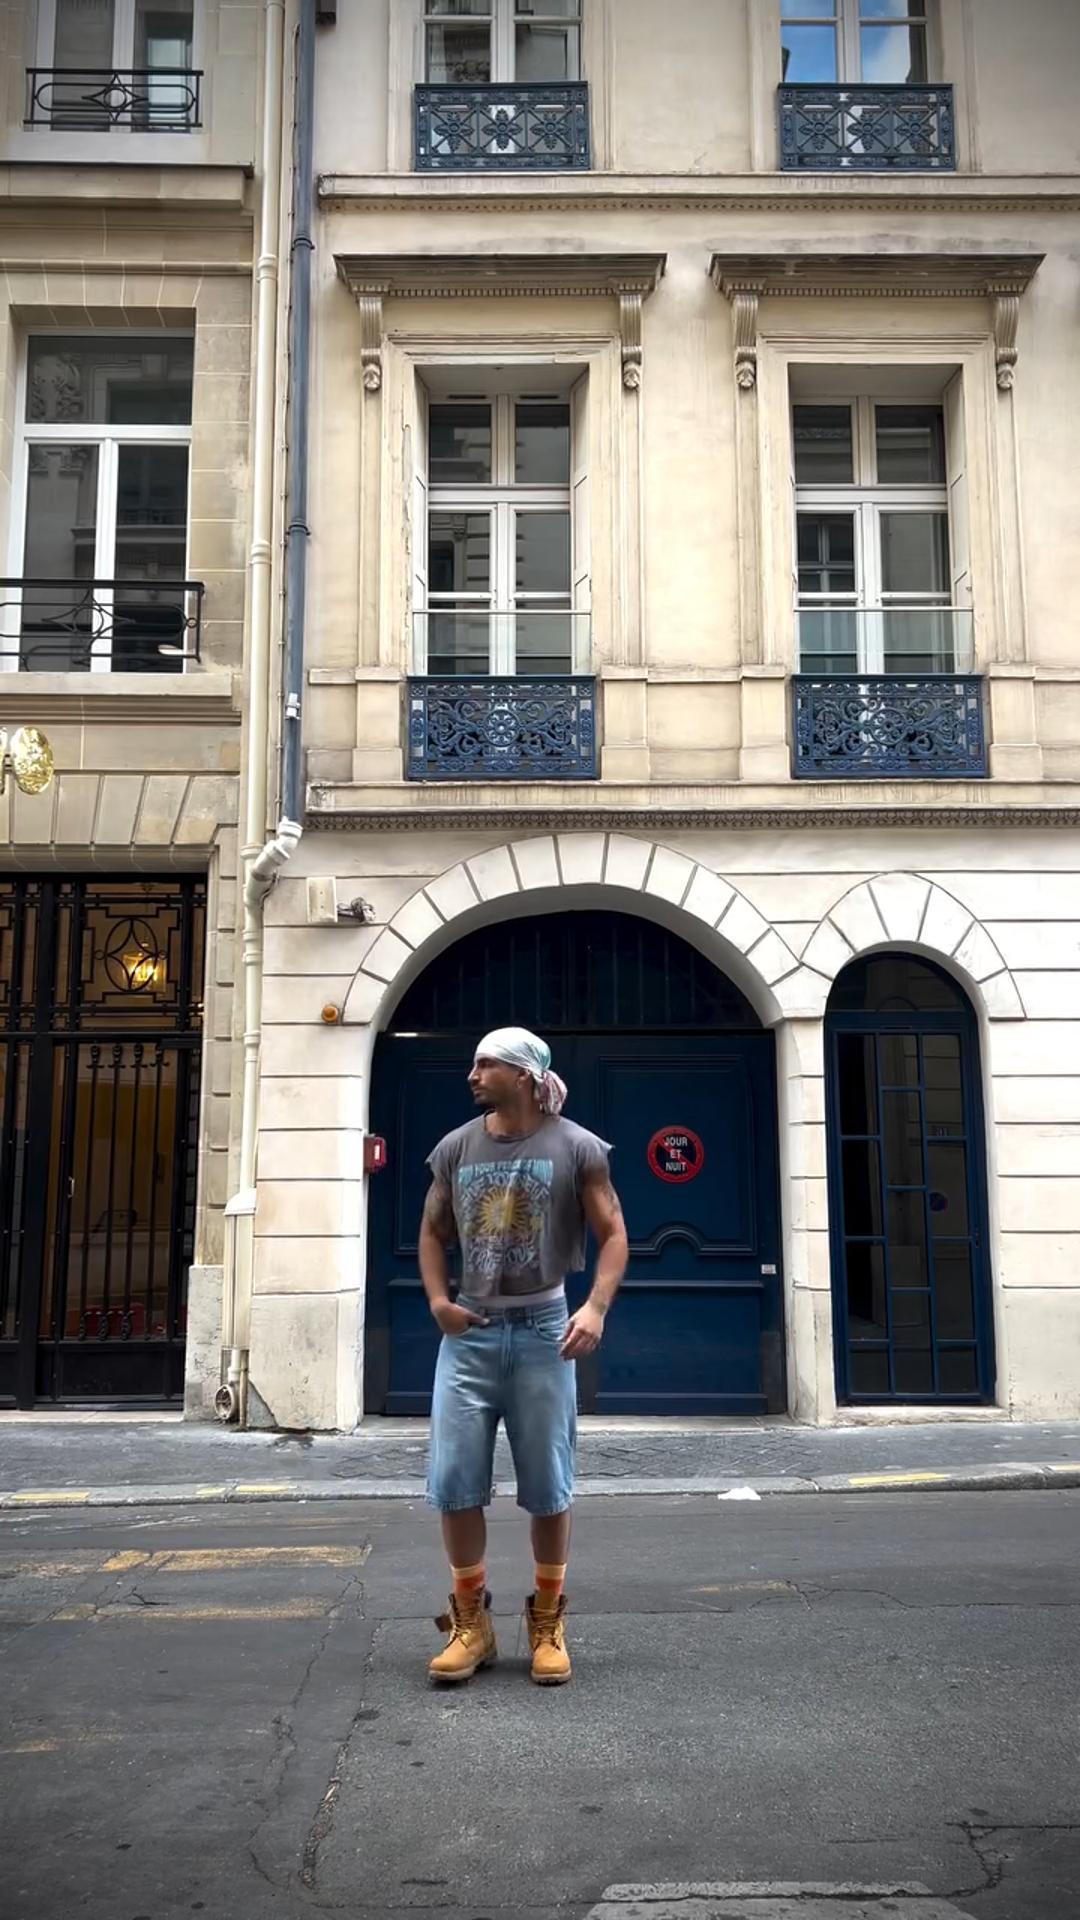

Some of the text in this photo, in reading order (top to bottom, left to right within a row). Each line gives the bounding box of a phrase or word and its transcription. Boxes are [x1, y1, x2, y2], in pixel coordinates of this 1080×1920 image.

[664, 1136, 688, 1146] JOUR
[670, 1149, 682, 1160] ET
[665, 1162, 686, 1172] NUIT
